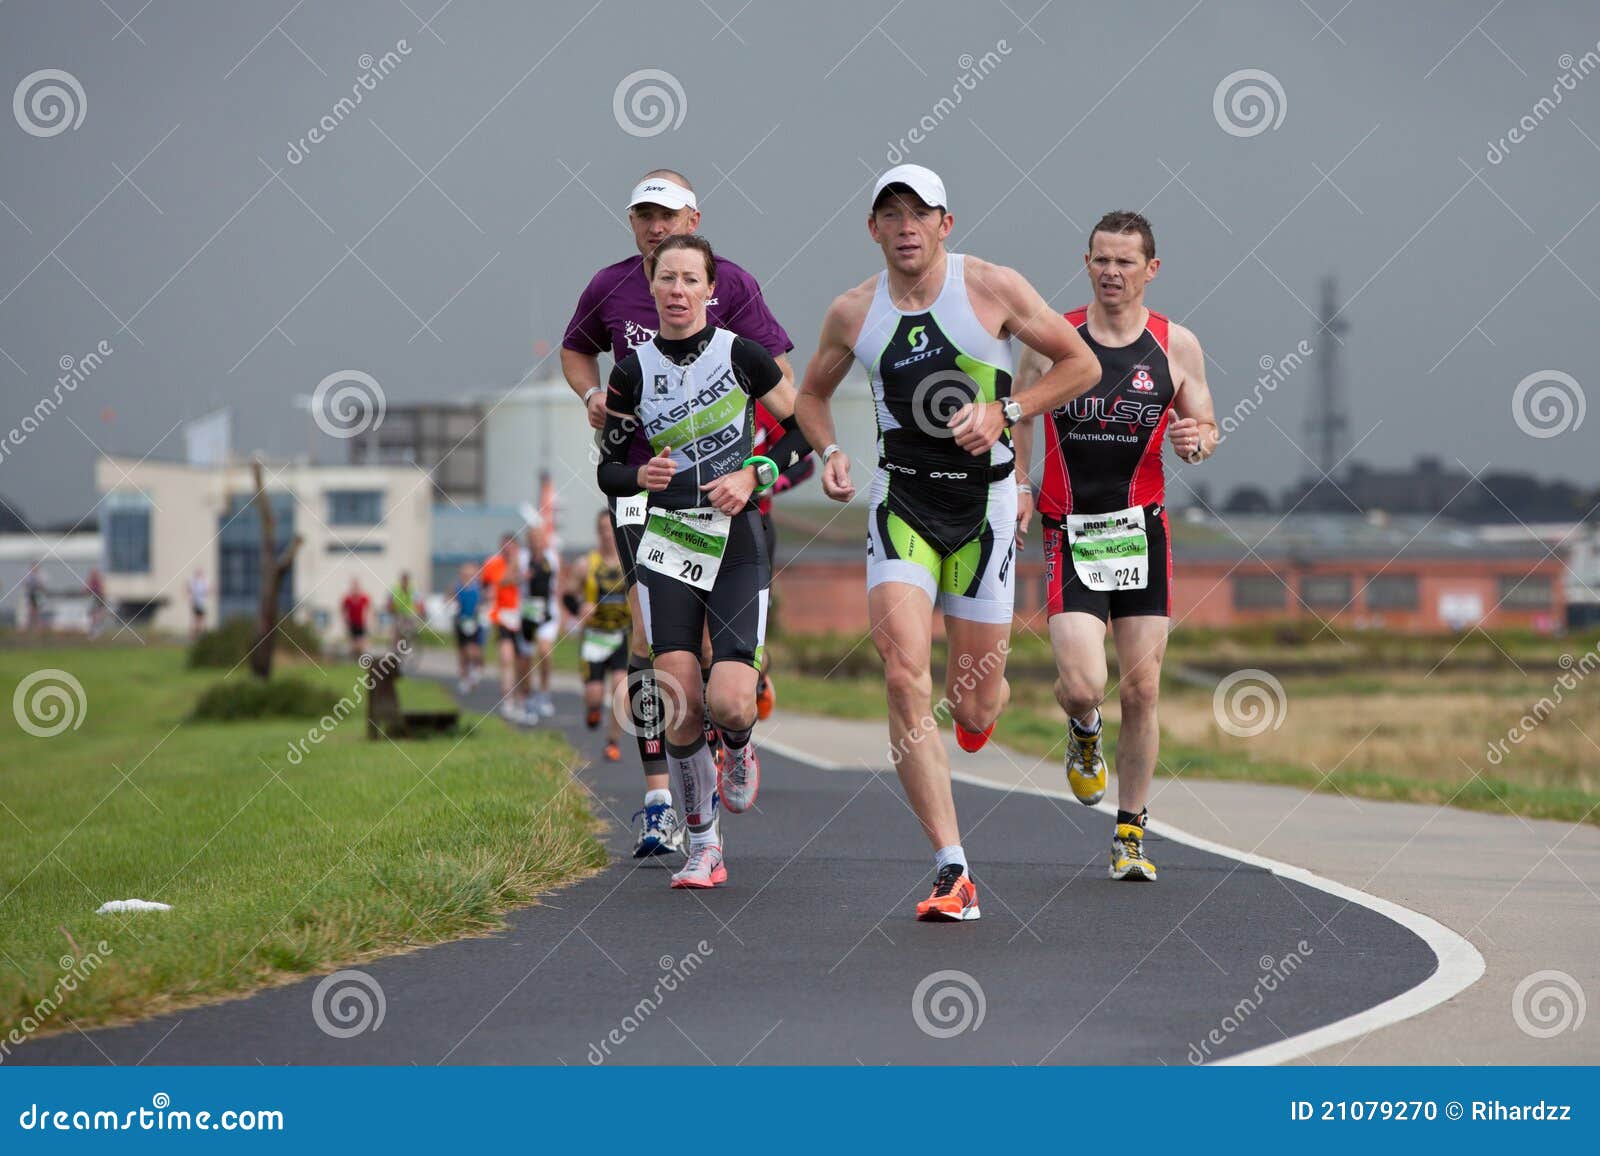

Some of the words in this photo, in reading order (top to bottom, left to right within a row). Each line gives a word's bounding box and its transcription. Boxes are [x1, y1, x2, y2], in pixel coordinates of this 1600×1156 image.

[893, 346, 944, 369] SCOTT
[1068, 432, 1115, 441] TRIATHLON
[1116, 434, 1139, 443] CLUB
[885, 463, 917, 475] orca
[930, 471, 968, 480] orca
[625, 506, 641, 517] IRL
[685, 532, 709, 549] Wolfe
[647, 548, 665, 564] IRL
[679, 560, 703, 582] 20
[1088, 571, 1105, 584] IRL
